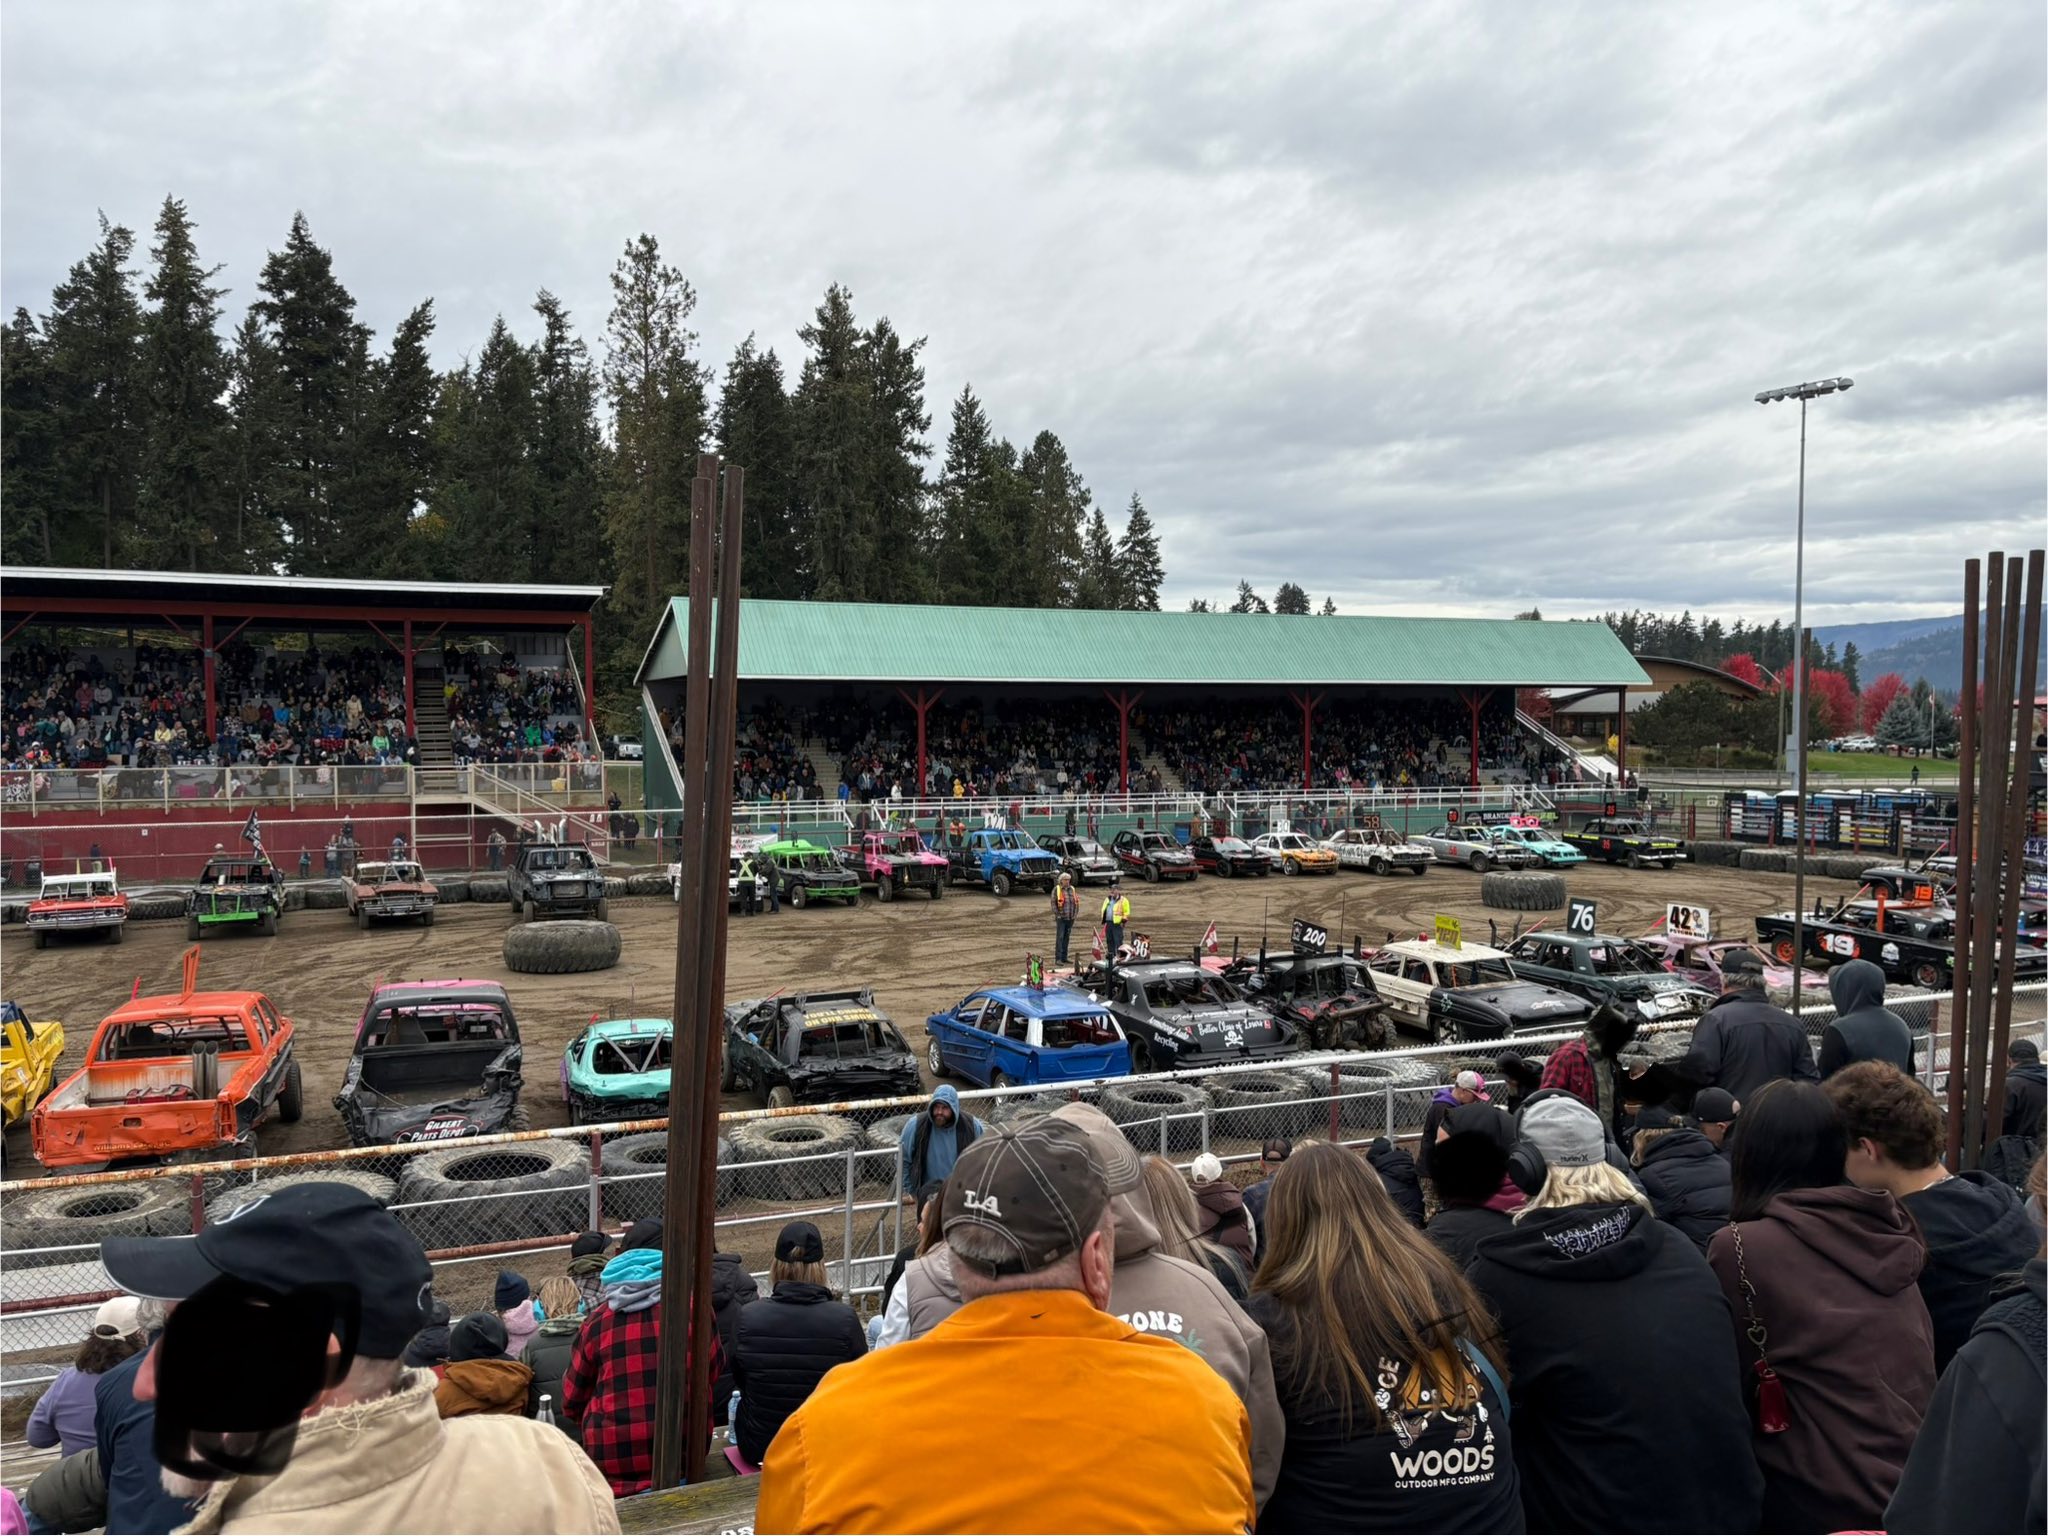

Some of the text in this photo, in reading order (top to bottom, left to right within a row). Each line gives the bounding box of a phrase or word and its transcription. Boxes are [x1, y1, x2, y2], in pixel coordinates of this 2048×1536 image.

[1363, 815, 1380, 829] 58
[1572, 903, 1594, 931] 76
[1670, 906, 1691, 930] 42
[1302, 927, 1326, 947] 200
[1823, 933, 1855, 956] 19
[1133, 939, 1149, 958] 36
[1154, 1032, 1179, 1052] Recycling
[410, 1128, 467, 1142] PARTS DEPOT
[425, 1119, 465, 1131] GILBERT
[963, 1189, 1002, 1217] LA
[1390, 1444, 1495, 1478] WOODS
[1394, 1472, 1495, 1489] OUTDOOR MFG COMPANY
